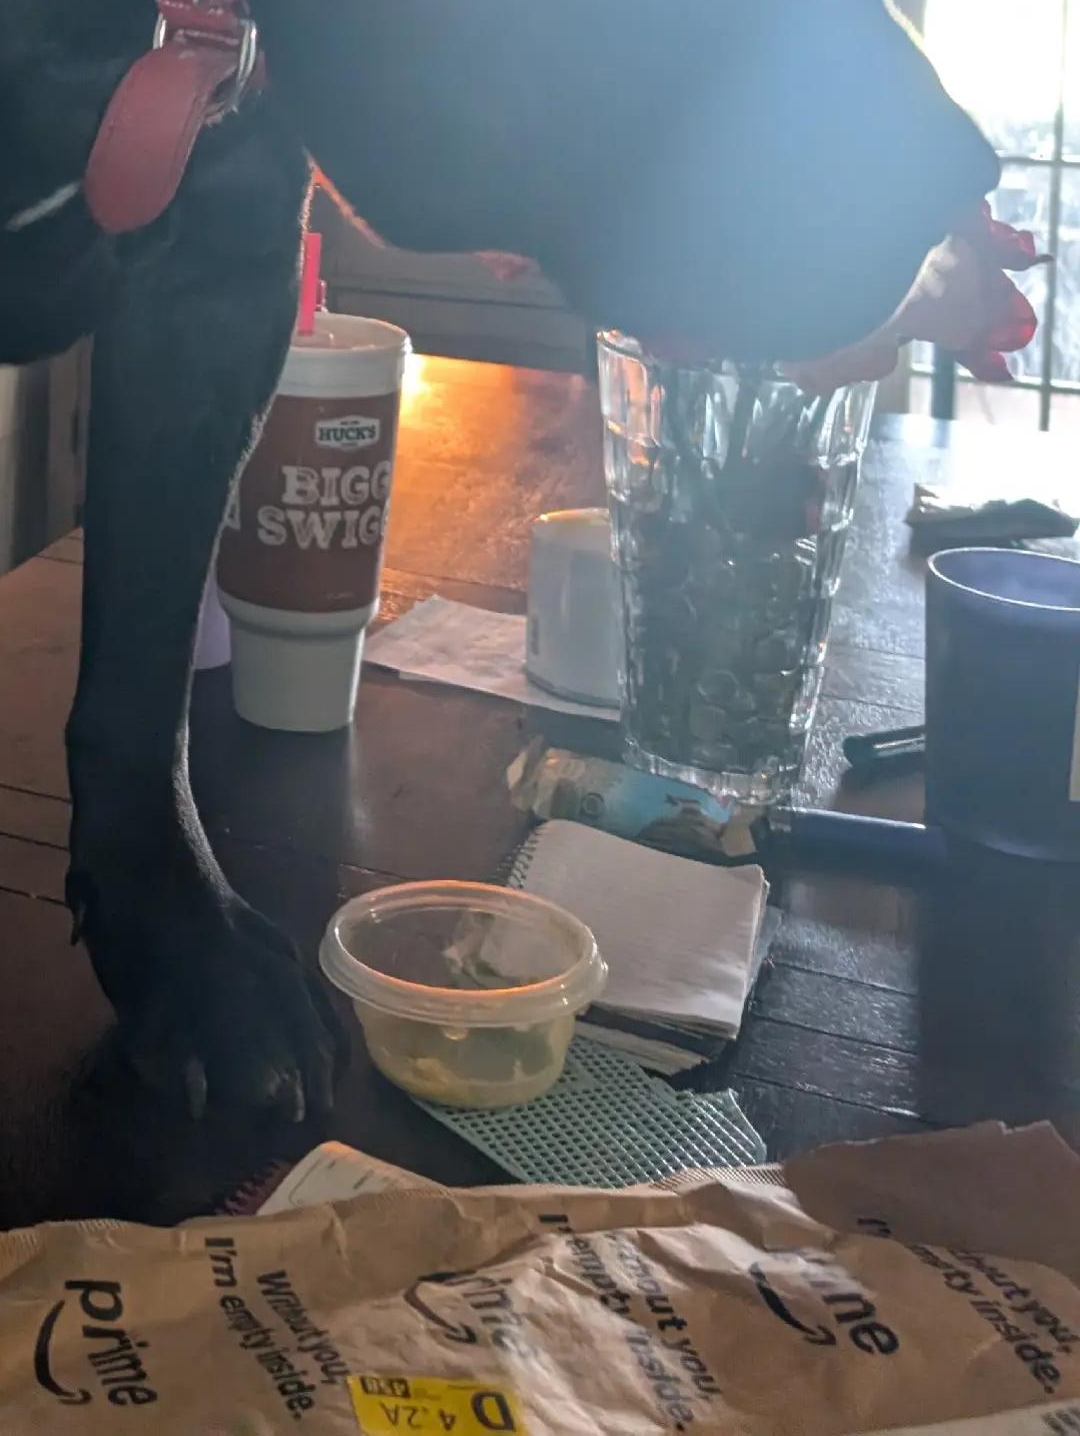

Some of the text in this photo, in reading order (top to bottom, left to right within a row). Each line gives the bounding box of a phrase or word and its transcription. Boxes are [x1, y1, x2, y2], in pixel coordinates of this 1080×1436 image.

[281, 461, 393, 506] BIGG
[204, 1236, 238, 1287] I'm
[64, 1280, 158, 1406] prime
[471, 1391, 517, 1433] D
